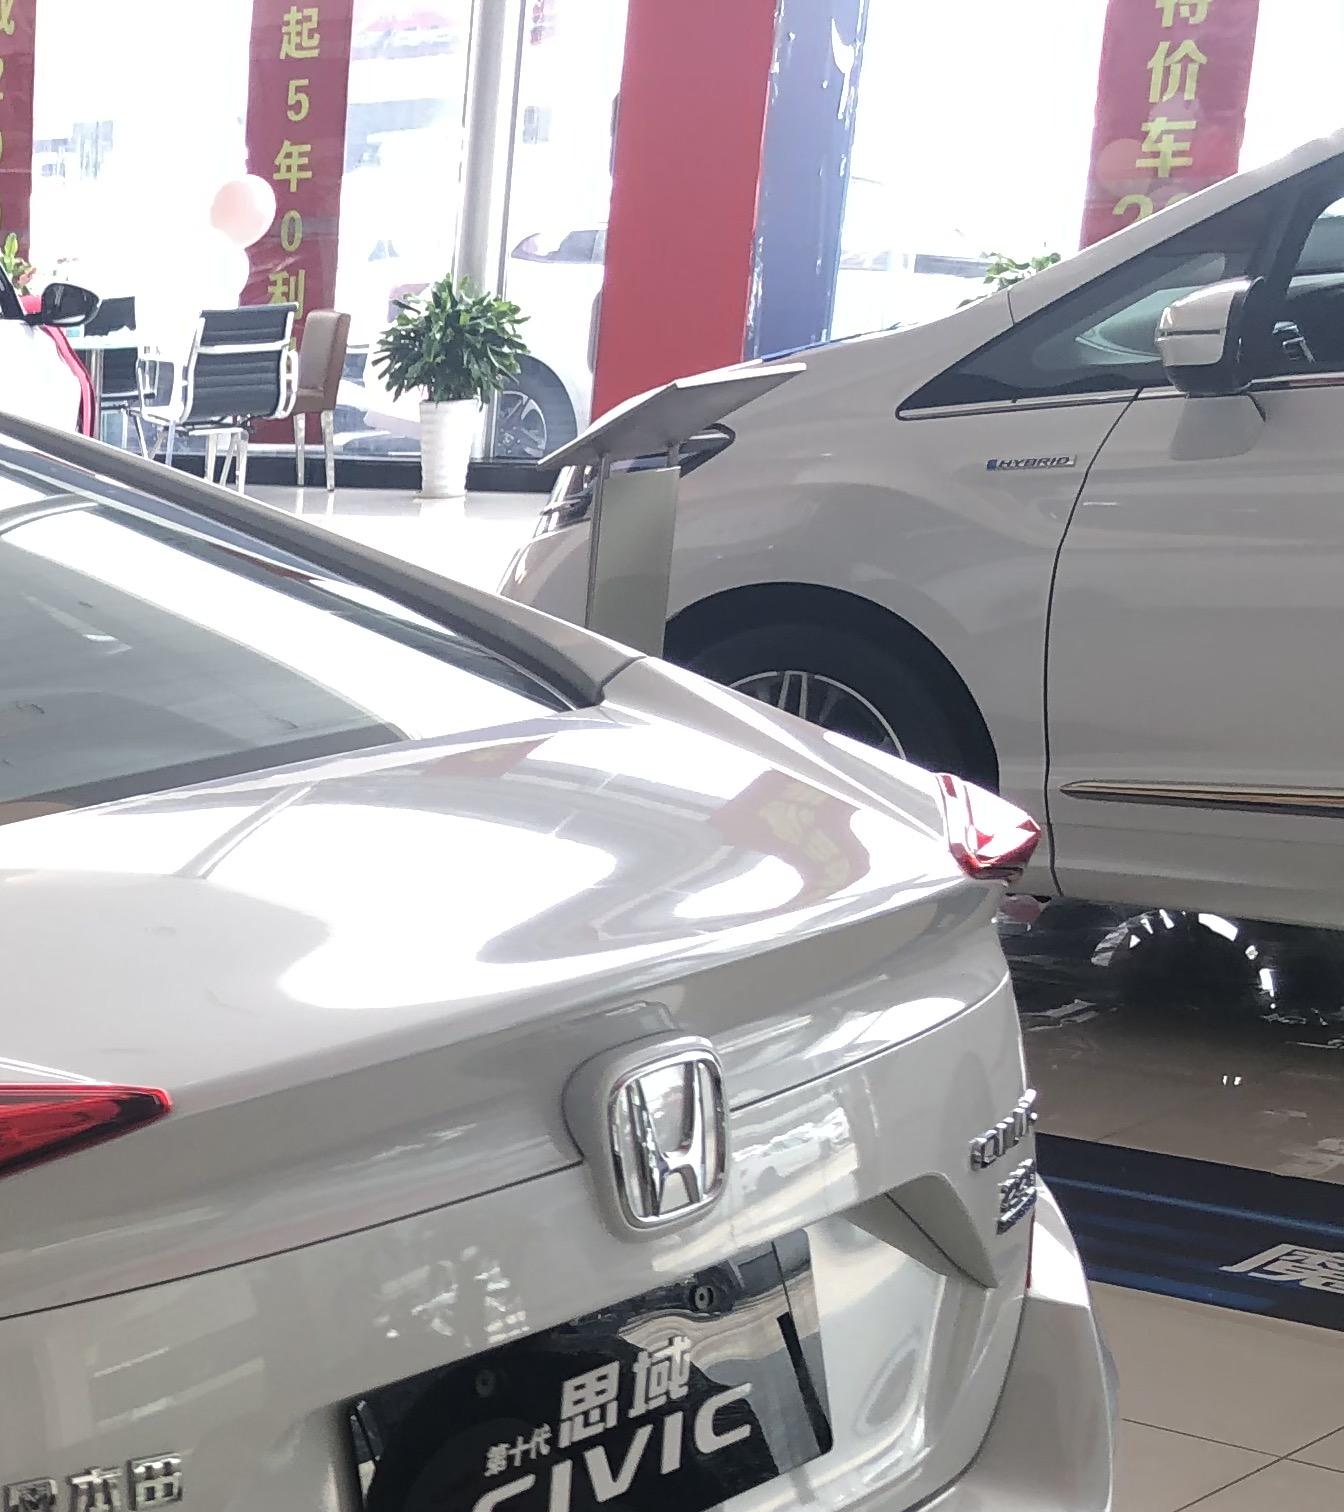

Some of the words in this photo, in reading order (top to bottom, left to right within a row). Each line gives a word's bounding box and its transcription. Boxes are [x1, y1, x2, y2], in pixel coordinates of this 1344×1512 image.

[267, 6, 320, 352] 起5年0利
[997, 456, 1071, 470] HYBRID
[558, 1335, 693, 1446] 思域
